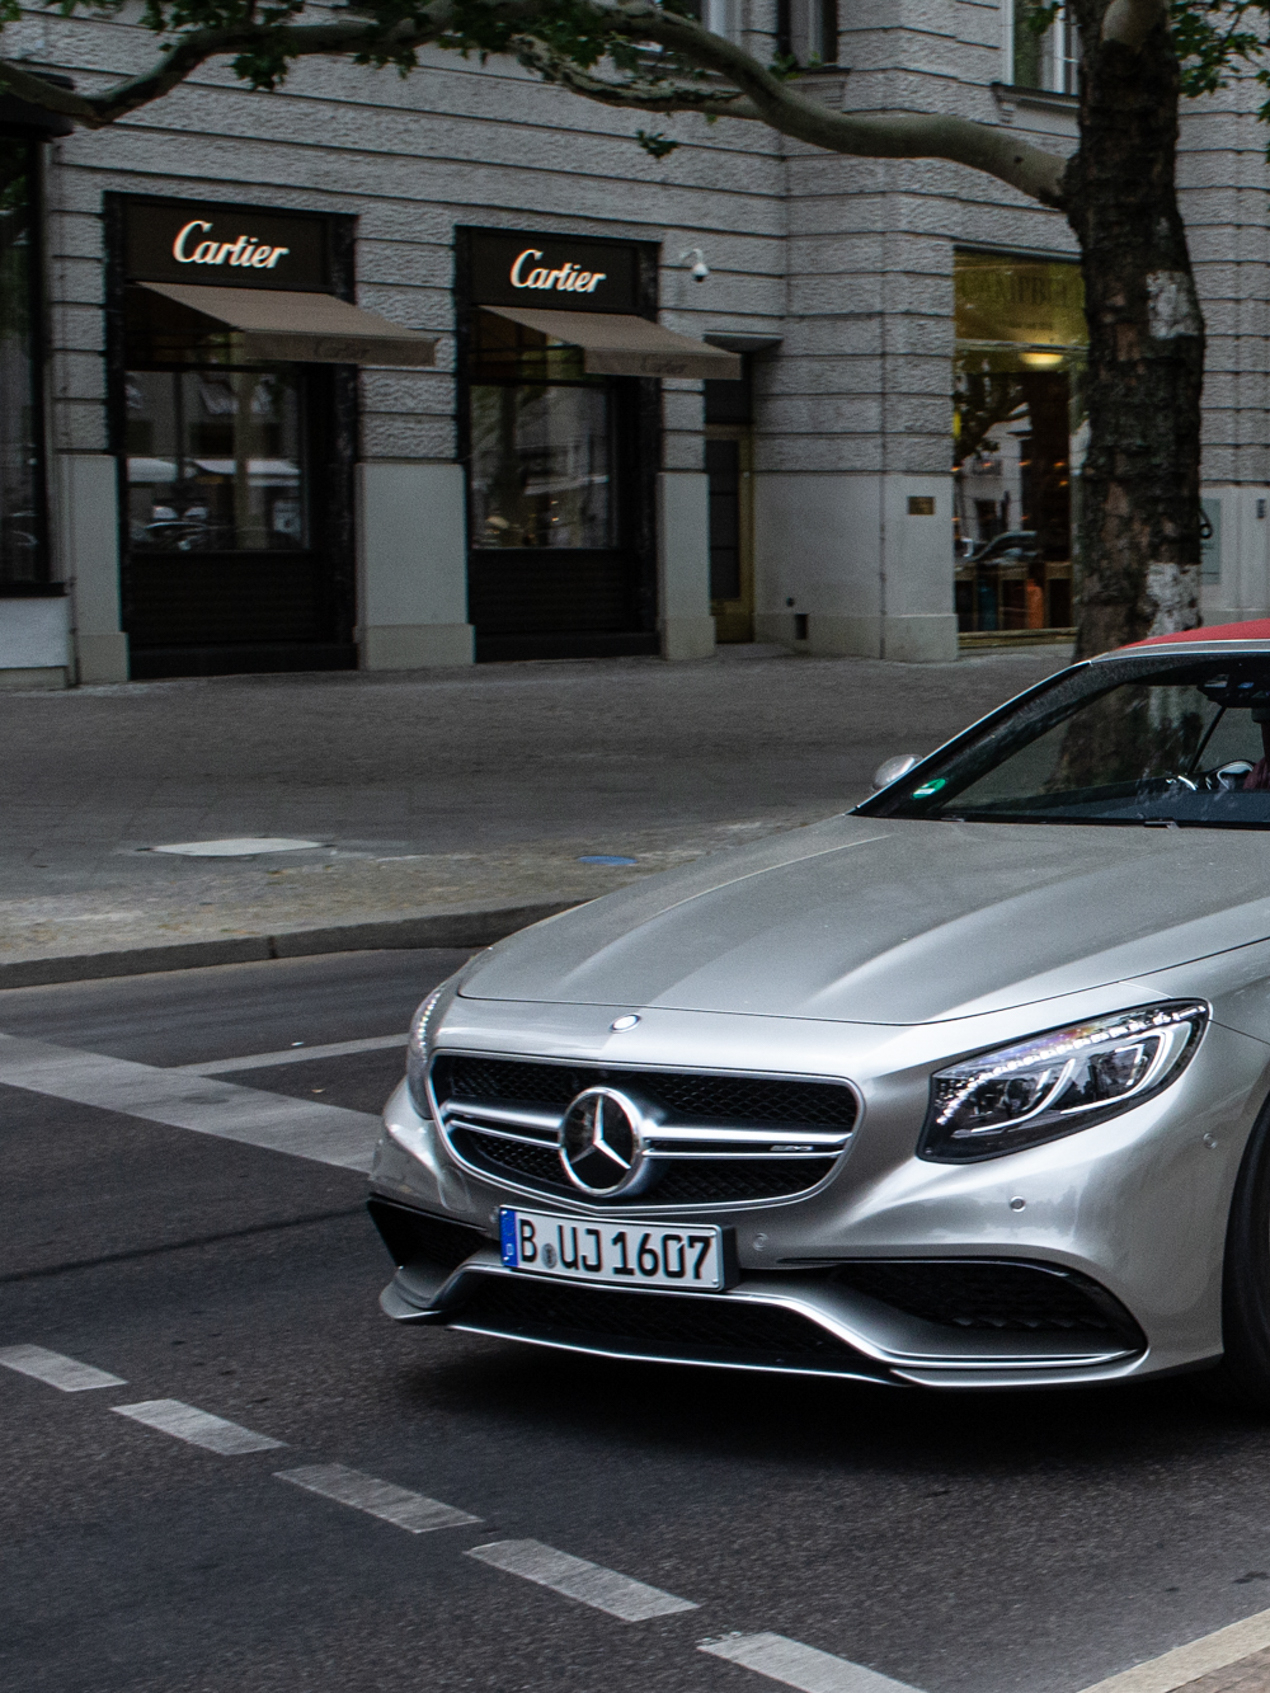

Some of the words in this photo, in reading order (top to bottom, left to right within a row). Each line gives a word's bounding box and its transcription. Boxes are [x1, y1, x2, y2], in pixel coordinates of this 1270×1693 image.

[172, 220, 290, 268] Cartier
[509, 248, 607, 293] Cartier
[519, 1218, 538, 1263] B
[557, 1224, 602, 1272] UJ
[611, 1231, 712, 1280] 1607
